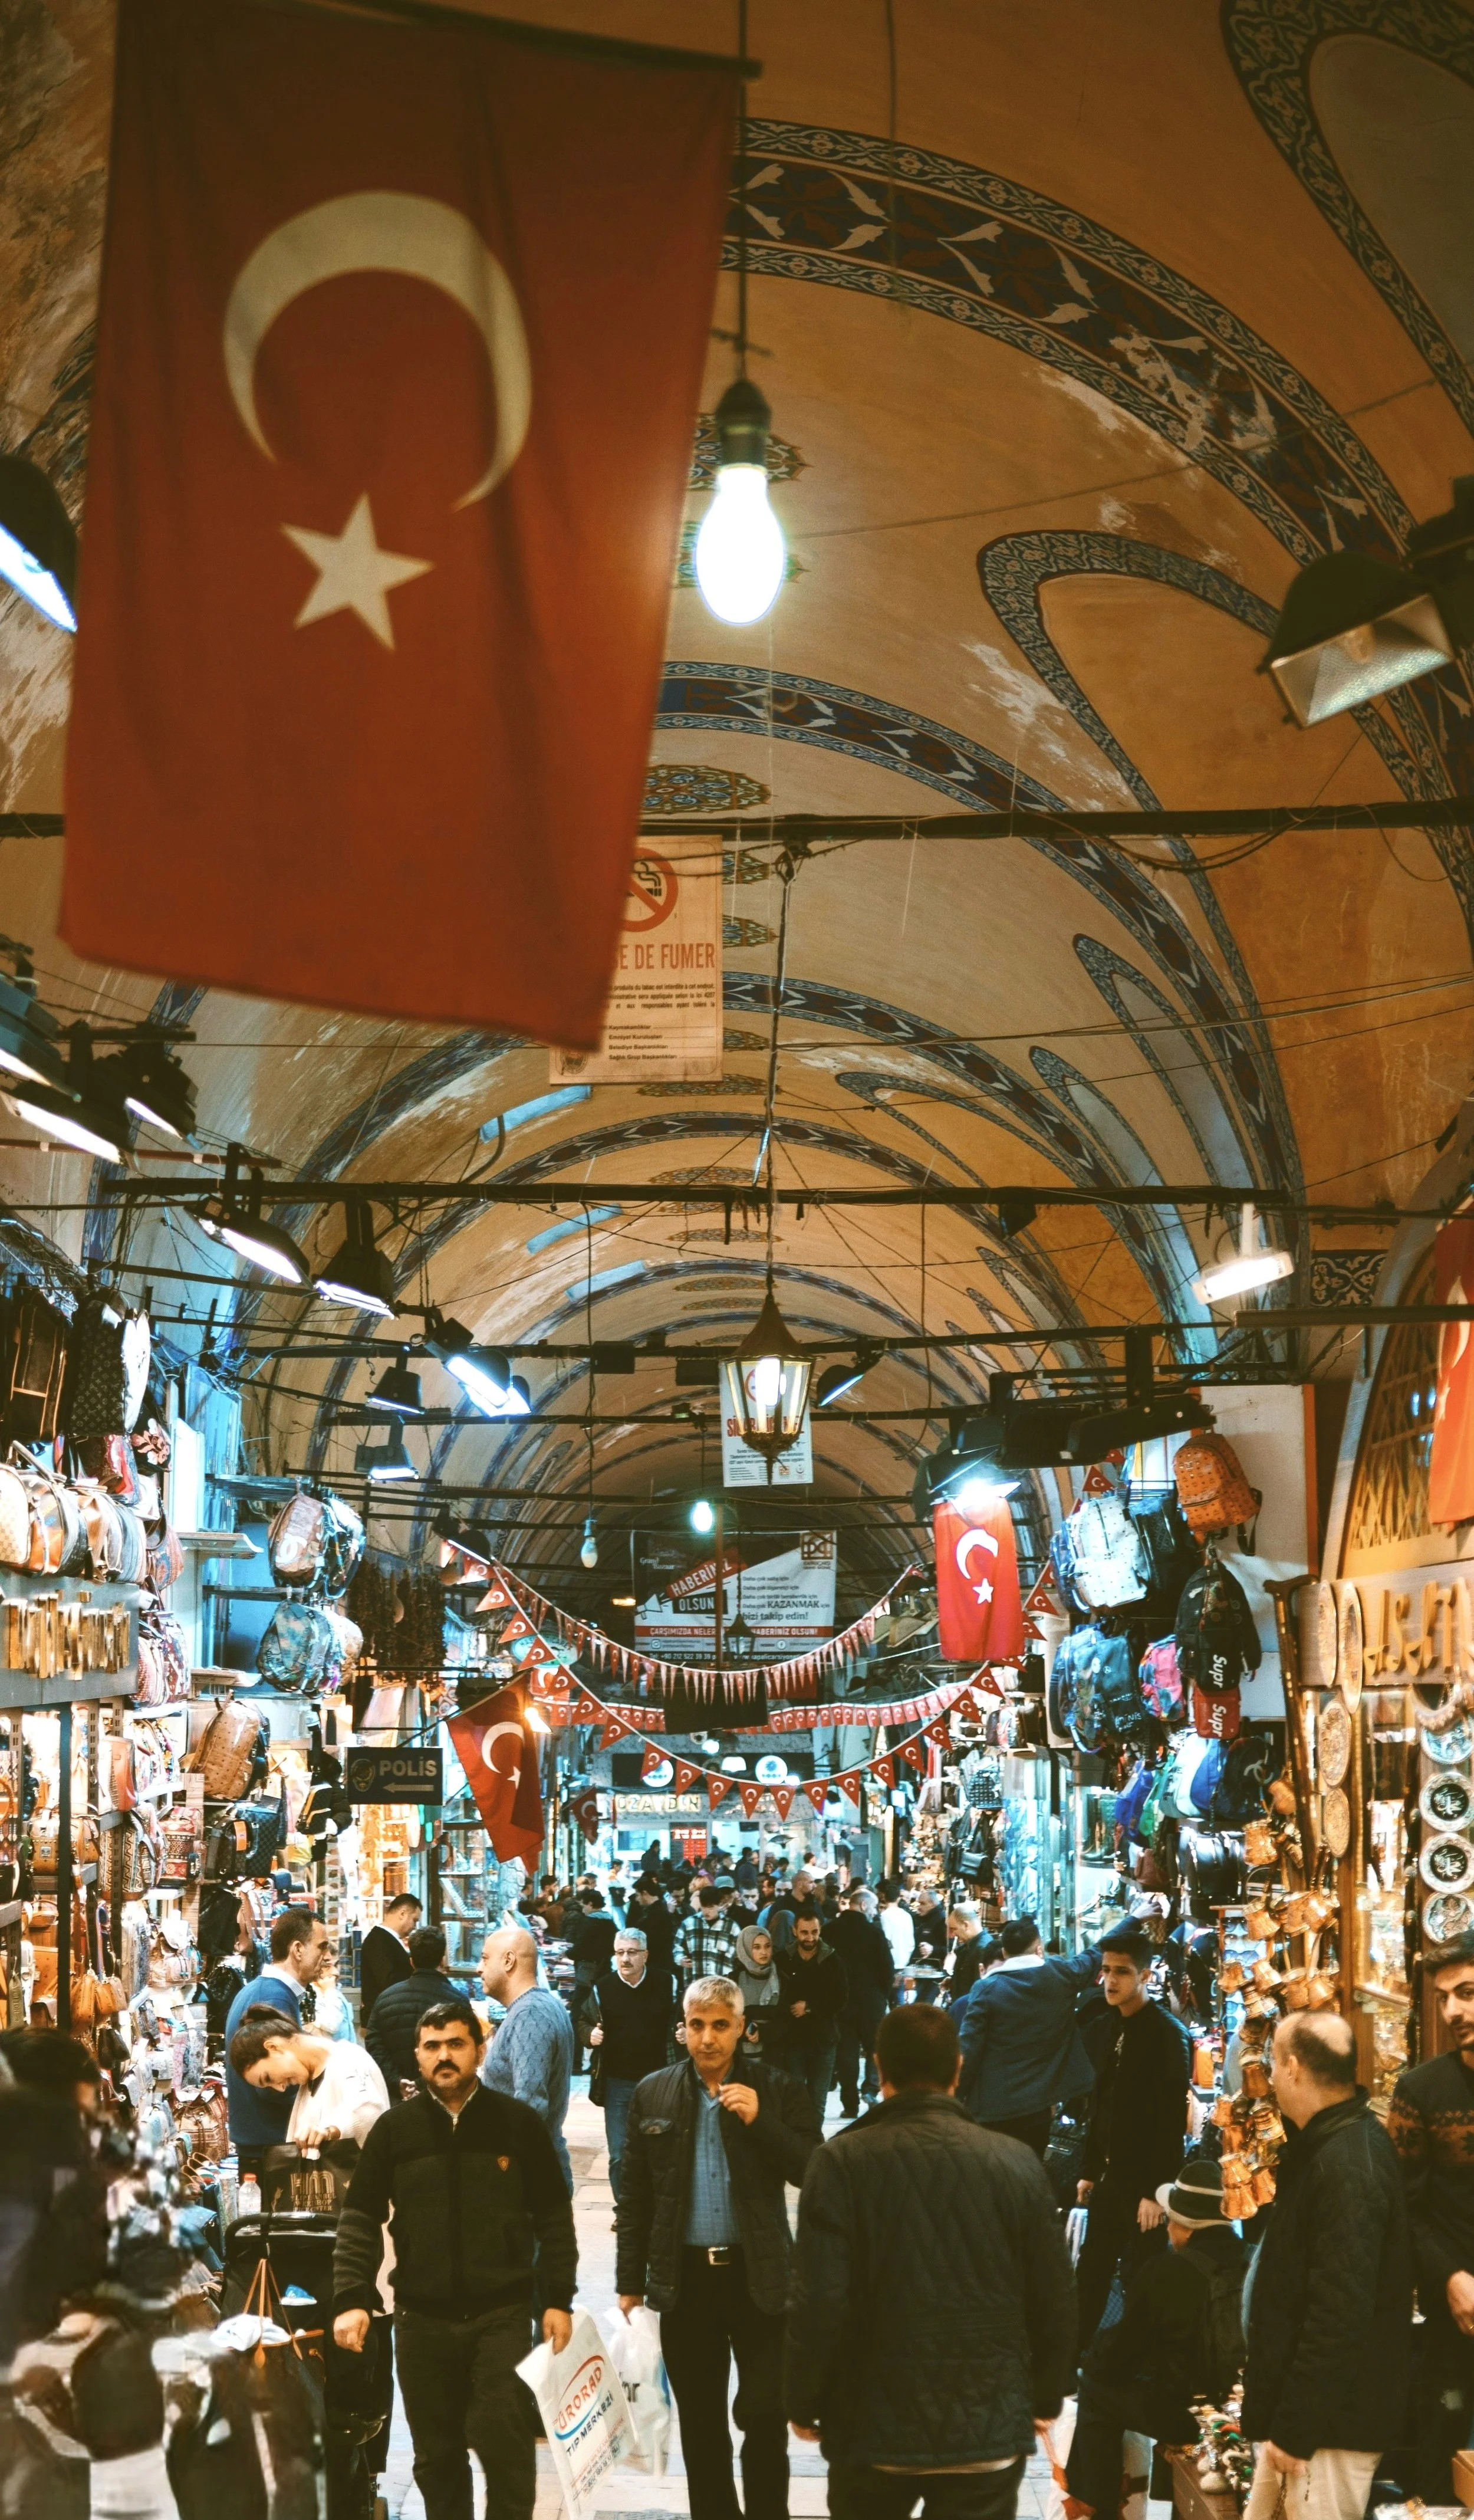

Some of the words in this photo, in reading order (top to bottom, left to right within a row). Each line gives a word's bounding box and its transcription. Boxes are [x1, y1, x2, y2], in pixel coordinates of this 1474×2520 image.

[635, 944, 654, 970] DE
[661, 943, 715, 969] FUMER
[670, 1558, 732, 1597] HABERİNZ
[679, 1597, 715, 1611] OLSUN
[743, 1612, 759, 1620] bizi
[760, 1612, 783, 1621] takip
[785, 1612, 809, 1620] edin!
[768, 1600, 820, 1608] KAZANMAK
[1208, 1654, 1228, 1688] Supr
[1208, 1703, 1226, 1737] Supr
[379, 1756, 437, 1777] POLİS
[566, 2436, 580, 2457] TIP
[581, 2390, 613, 2442] MERKEZİ
